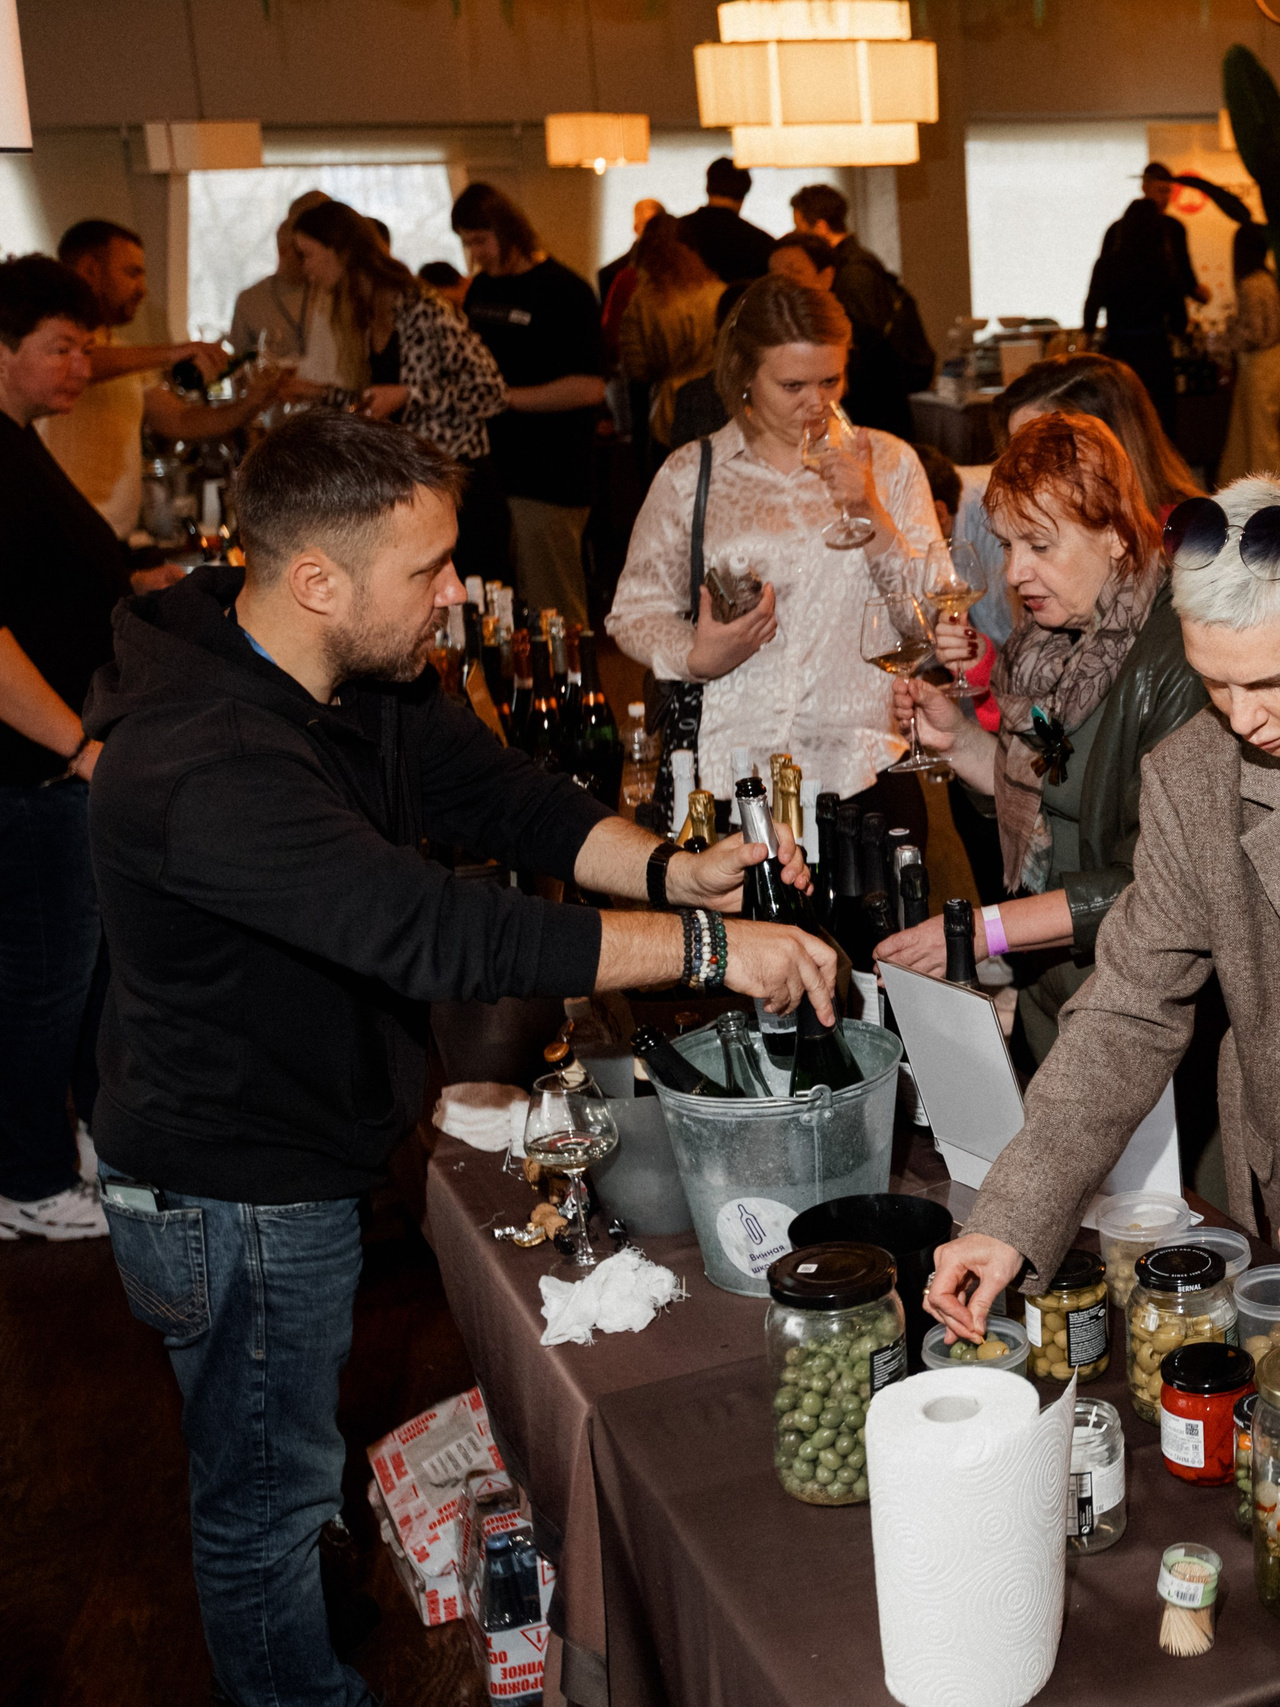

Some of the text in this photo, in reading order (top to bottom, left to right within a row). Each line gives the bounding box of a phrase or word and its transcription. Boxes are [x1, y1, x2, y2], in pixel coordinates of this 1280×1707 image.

[749, 1245, 785, 1261] Винная
[751, 1263, 772, 1274] шко
[1177, 1283, 1202, 1293] BERNAL
[500, 1660, 544, 1680] УПКОЕ
